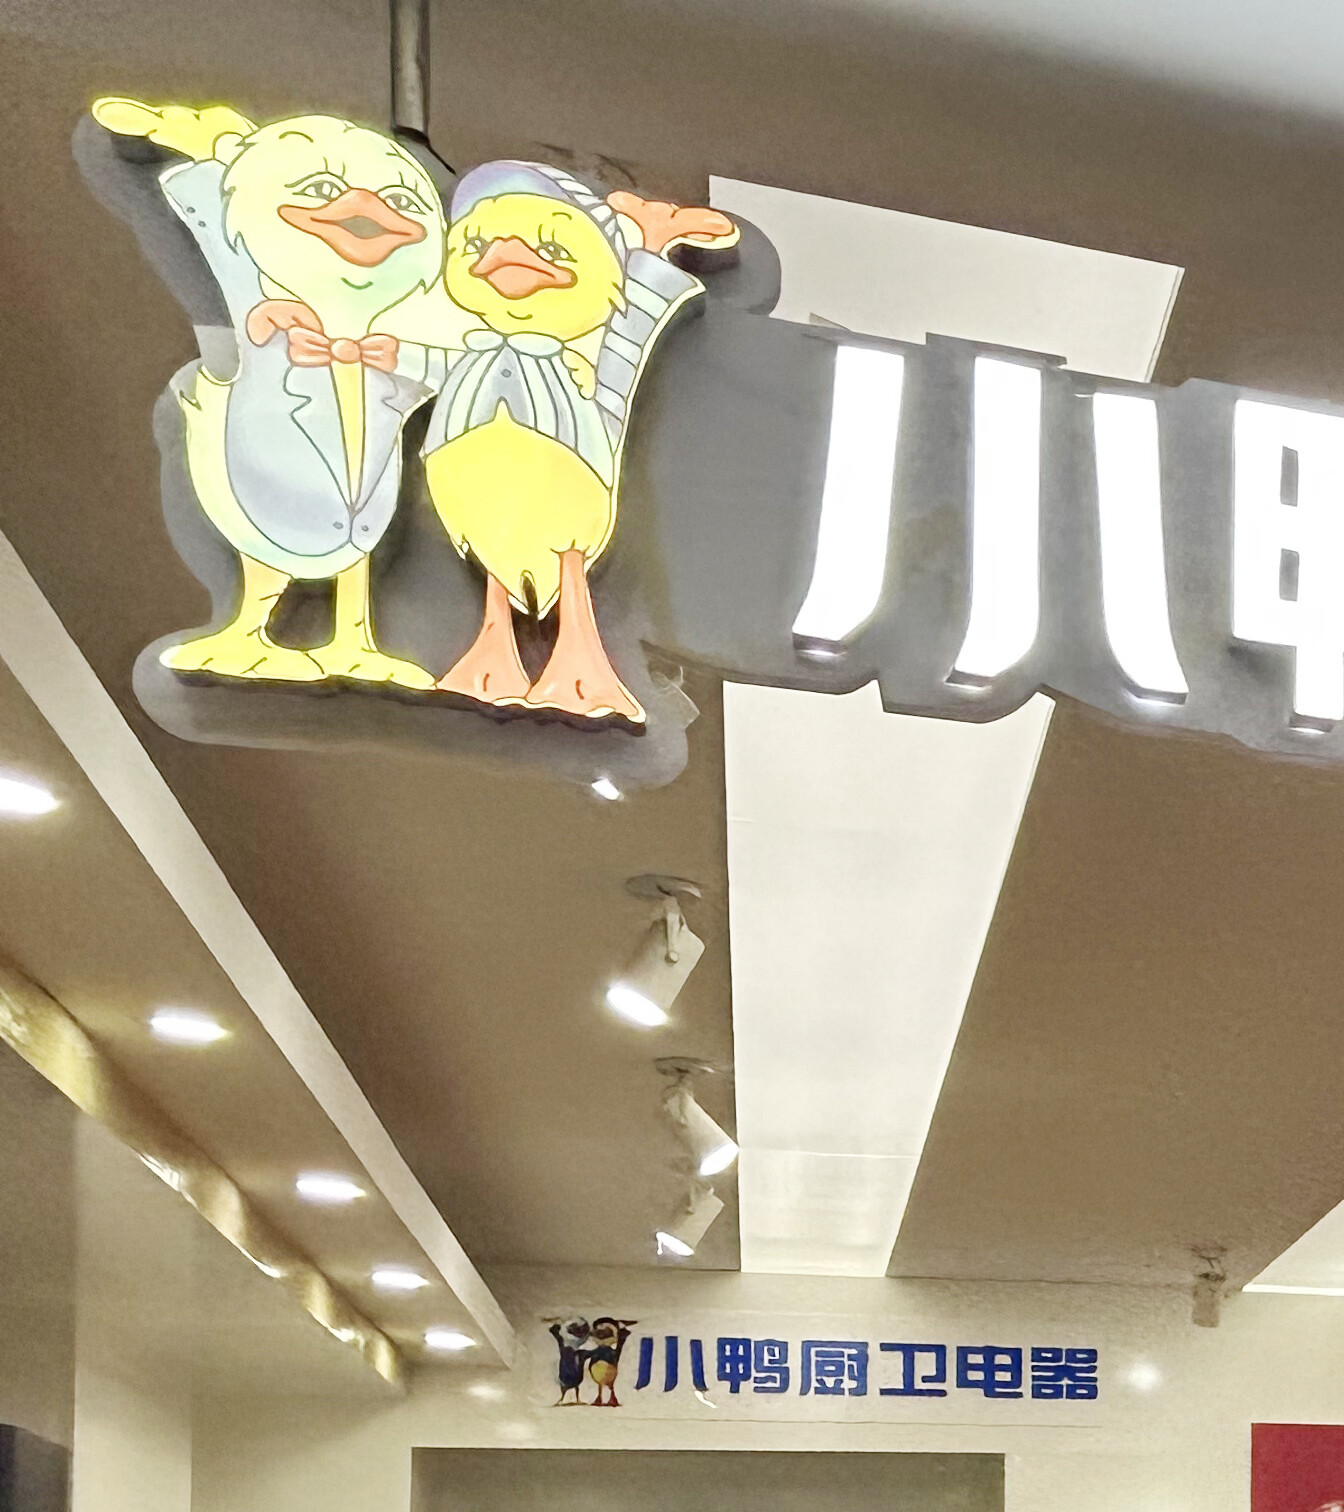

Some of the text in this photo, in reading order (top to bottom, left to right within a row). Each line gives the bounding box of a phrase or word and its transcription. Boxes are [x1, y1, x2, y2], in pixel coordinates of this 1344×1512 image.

[635, 1335, 1099, 1401] 小鸭厨卫电器
